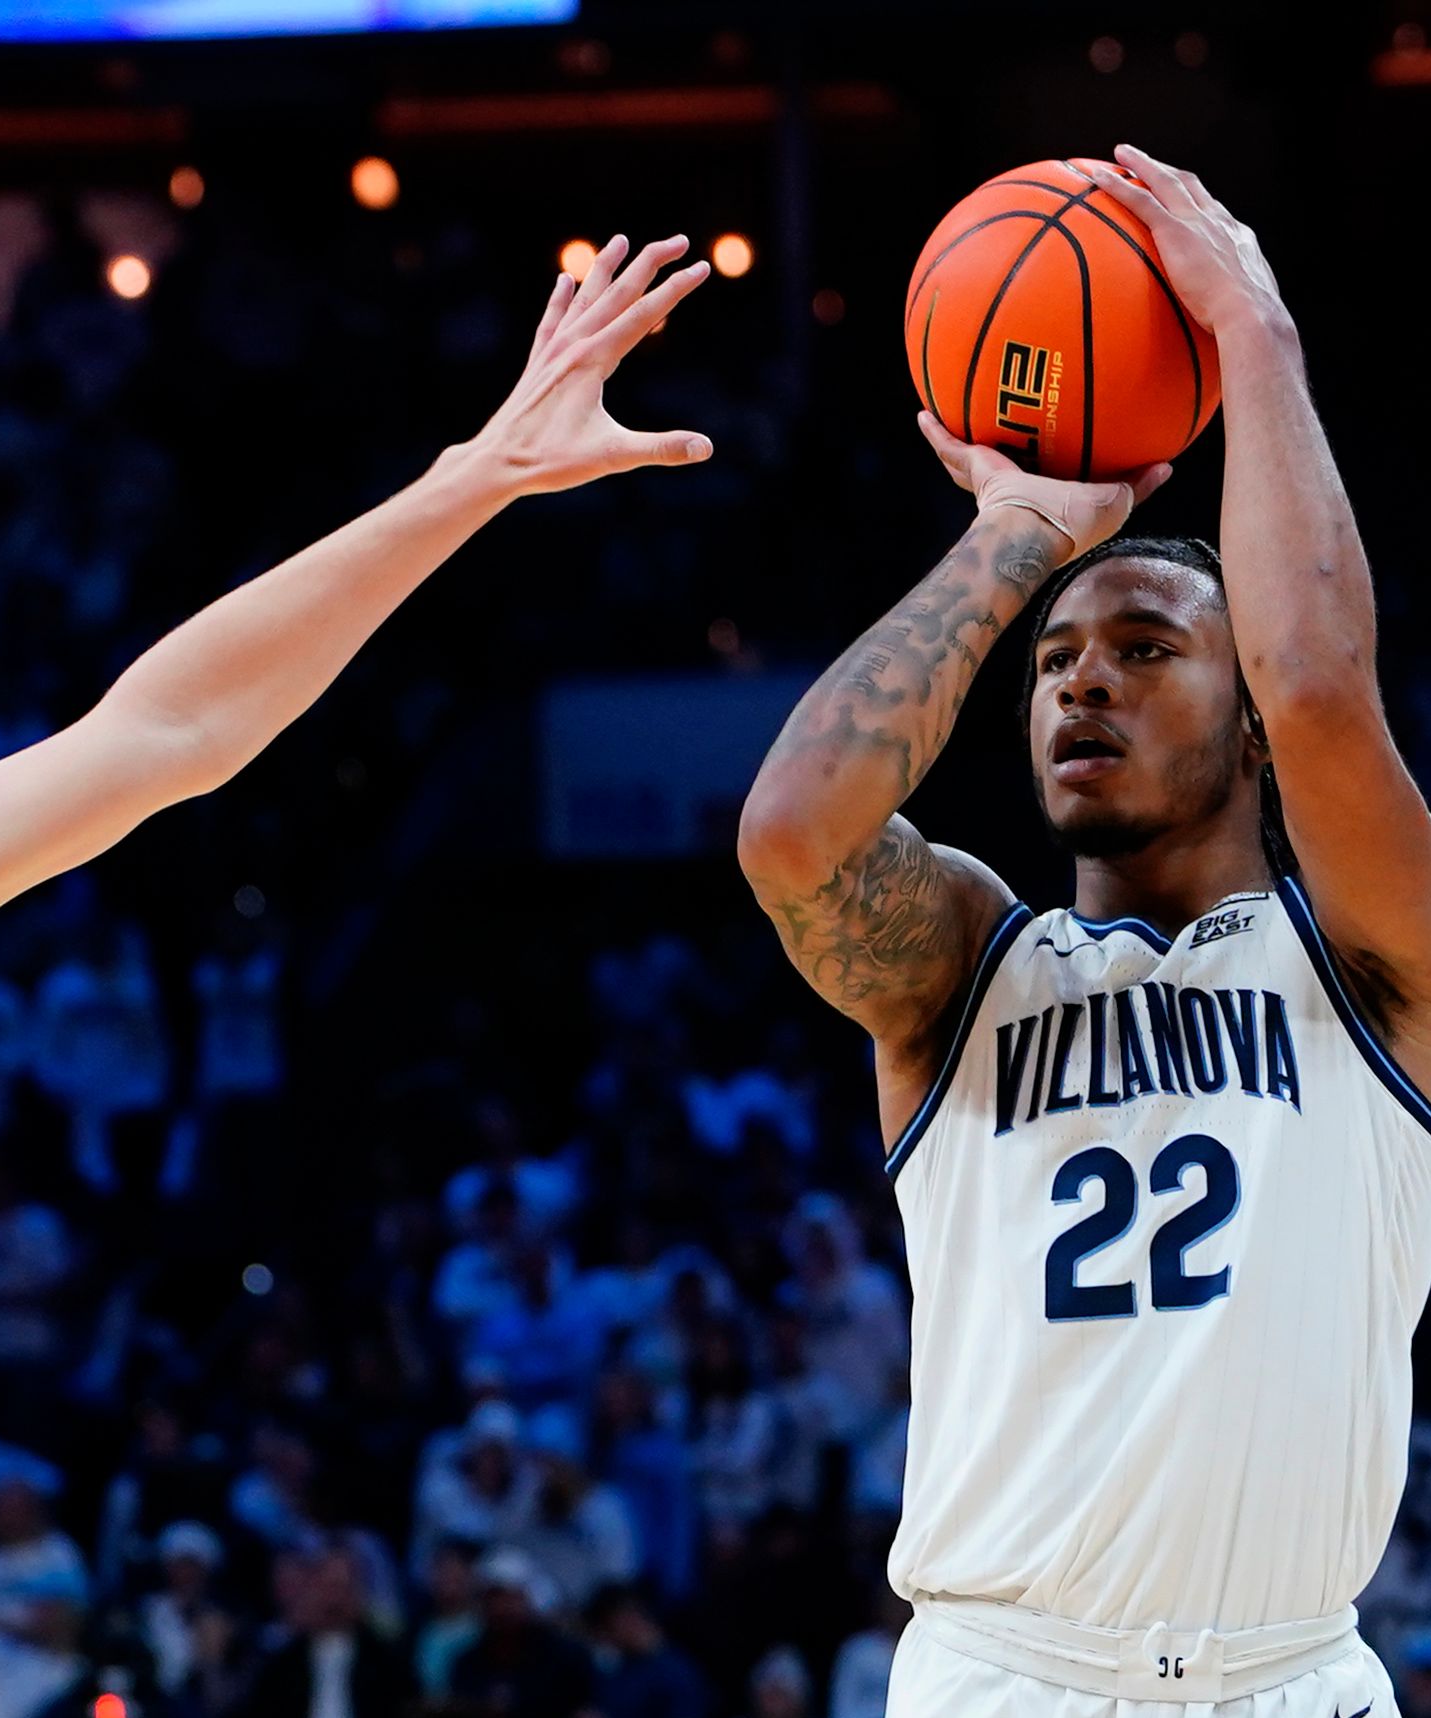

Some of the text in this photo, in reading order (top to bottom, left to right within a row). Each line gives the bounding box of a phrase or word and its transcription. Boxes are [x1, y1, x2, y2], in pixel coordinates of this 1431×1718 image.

[1191, 914, 1256, 944] EAST
[1196, 909, 1240, 932] BIG
[994, 981, 1302, 1138] VILLANOVA
[1045, 1133, 1242, 1324] 22
